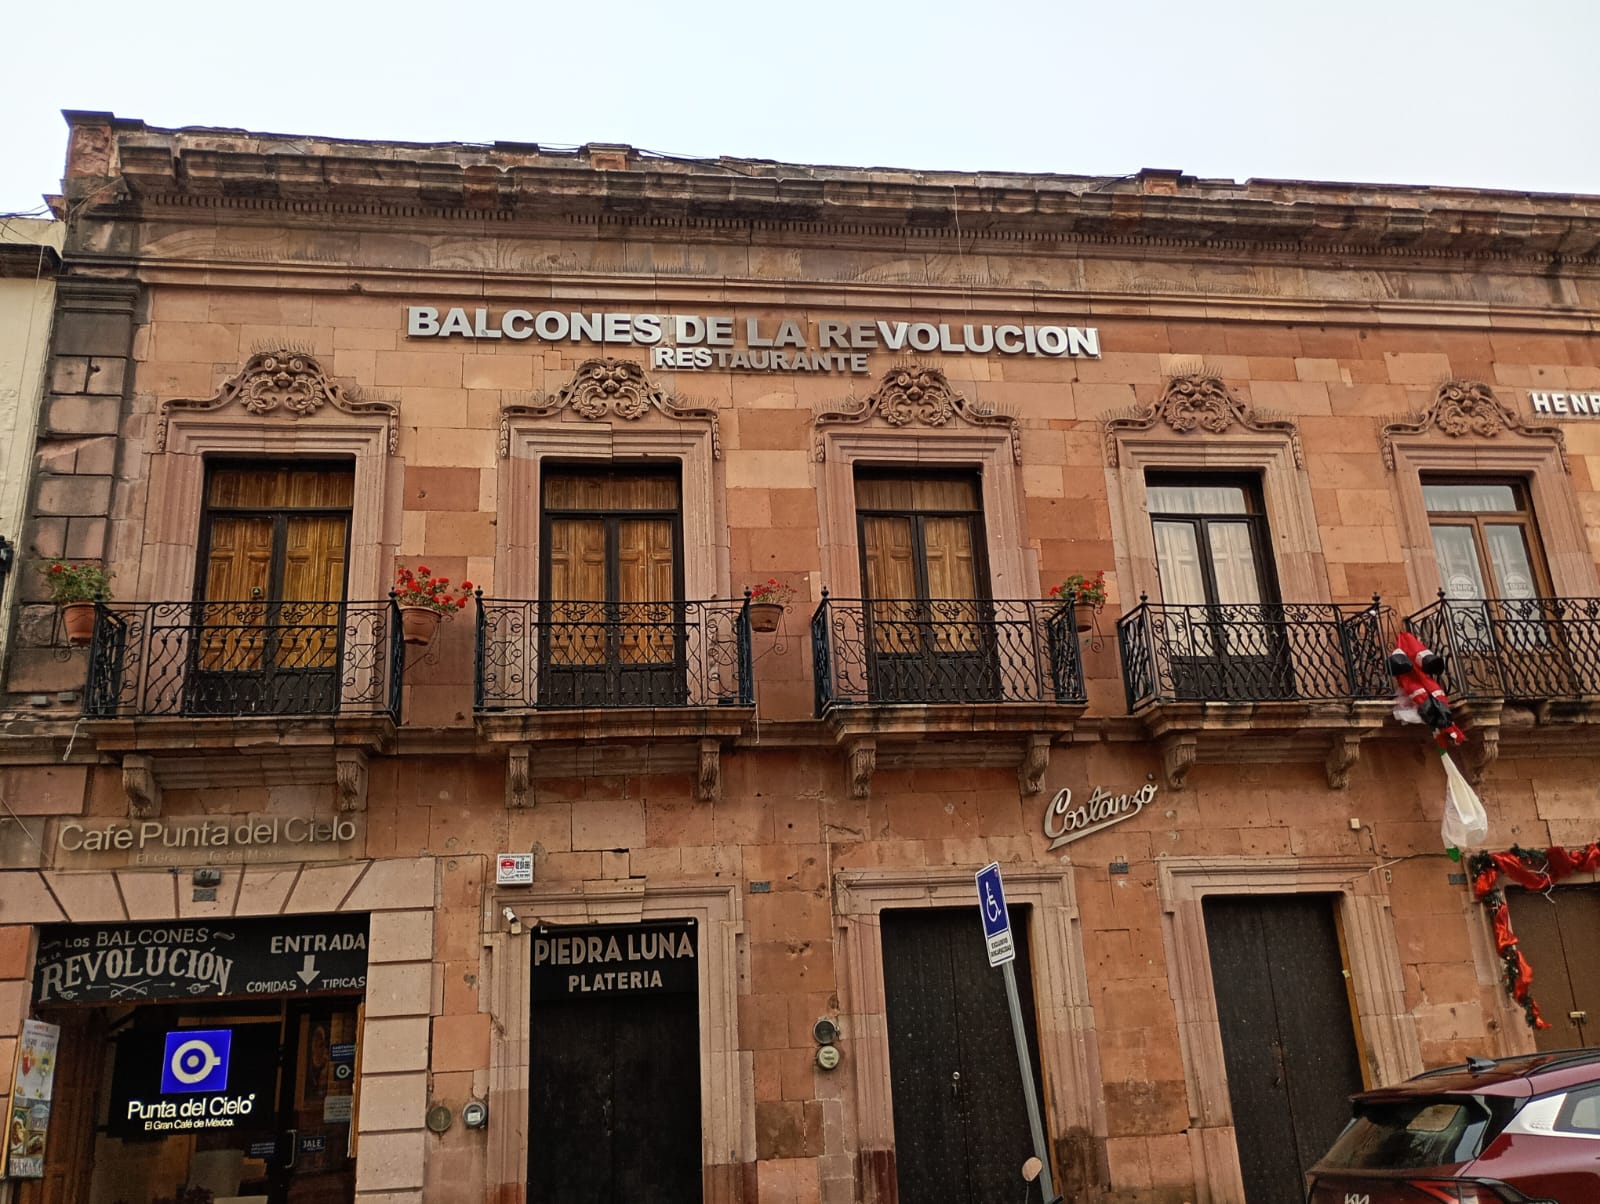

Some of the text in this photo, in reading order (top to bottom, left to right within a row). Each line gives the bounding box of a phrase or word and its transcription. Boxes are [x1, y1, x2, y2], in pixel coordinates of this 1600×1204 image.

[407, 306, 1099, 356] BALCONES DE LA REVOLUCION
[654, 347, 869, 374] RESTAURANTE
[1044, 784, 1158, 851] Costanzo
[138, 822, 229, 849] Punta
[234, 817, 279, 844] del
[284, 814, 356, 843] Cielo
[96, 928, 209, 947] BALCONES
[270, 932, 367, 954] ENTRADA
[534, 931, 695, 967] PIEDRA LUNA
[38, 946, 234, 1003] REVOLUCIÓN
[246, 976, 366, 993] COMIDAS TIPICAS
[568, 970, 663, 993] PLATERIA
[127, 1101, 176, 1120] Punta
[180, 1098, 206, 1117] del
[144, 1121, 152, 1131] El
[153, 1120, 173, 1130] Gran
[193, 1119, 205, 1128] de
